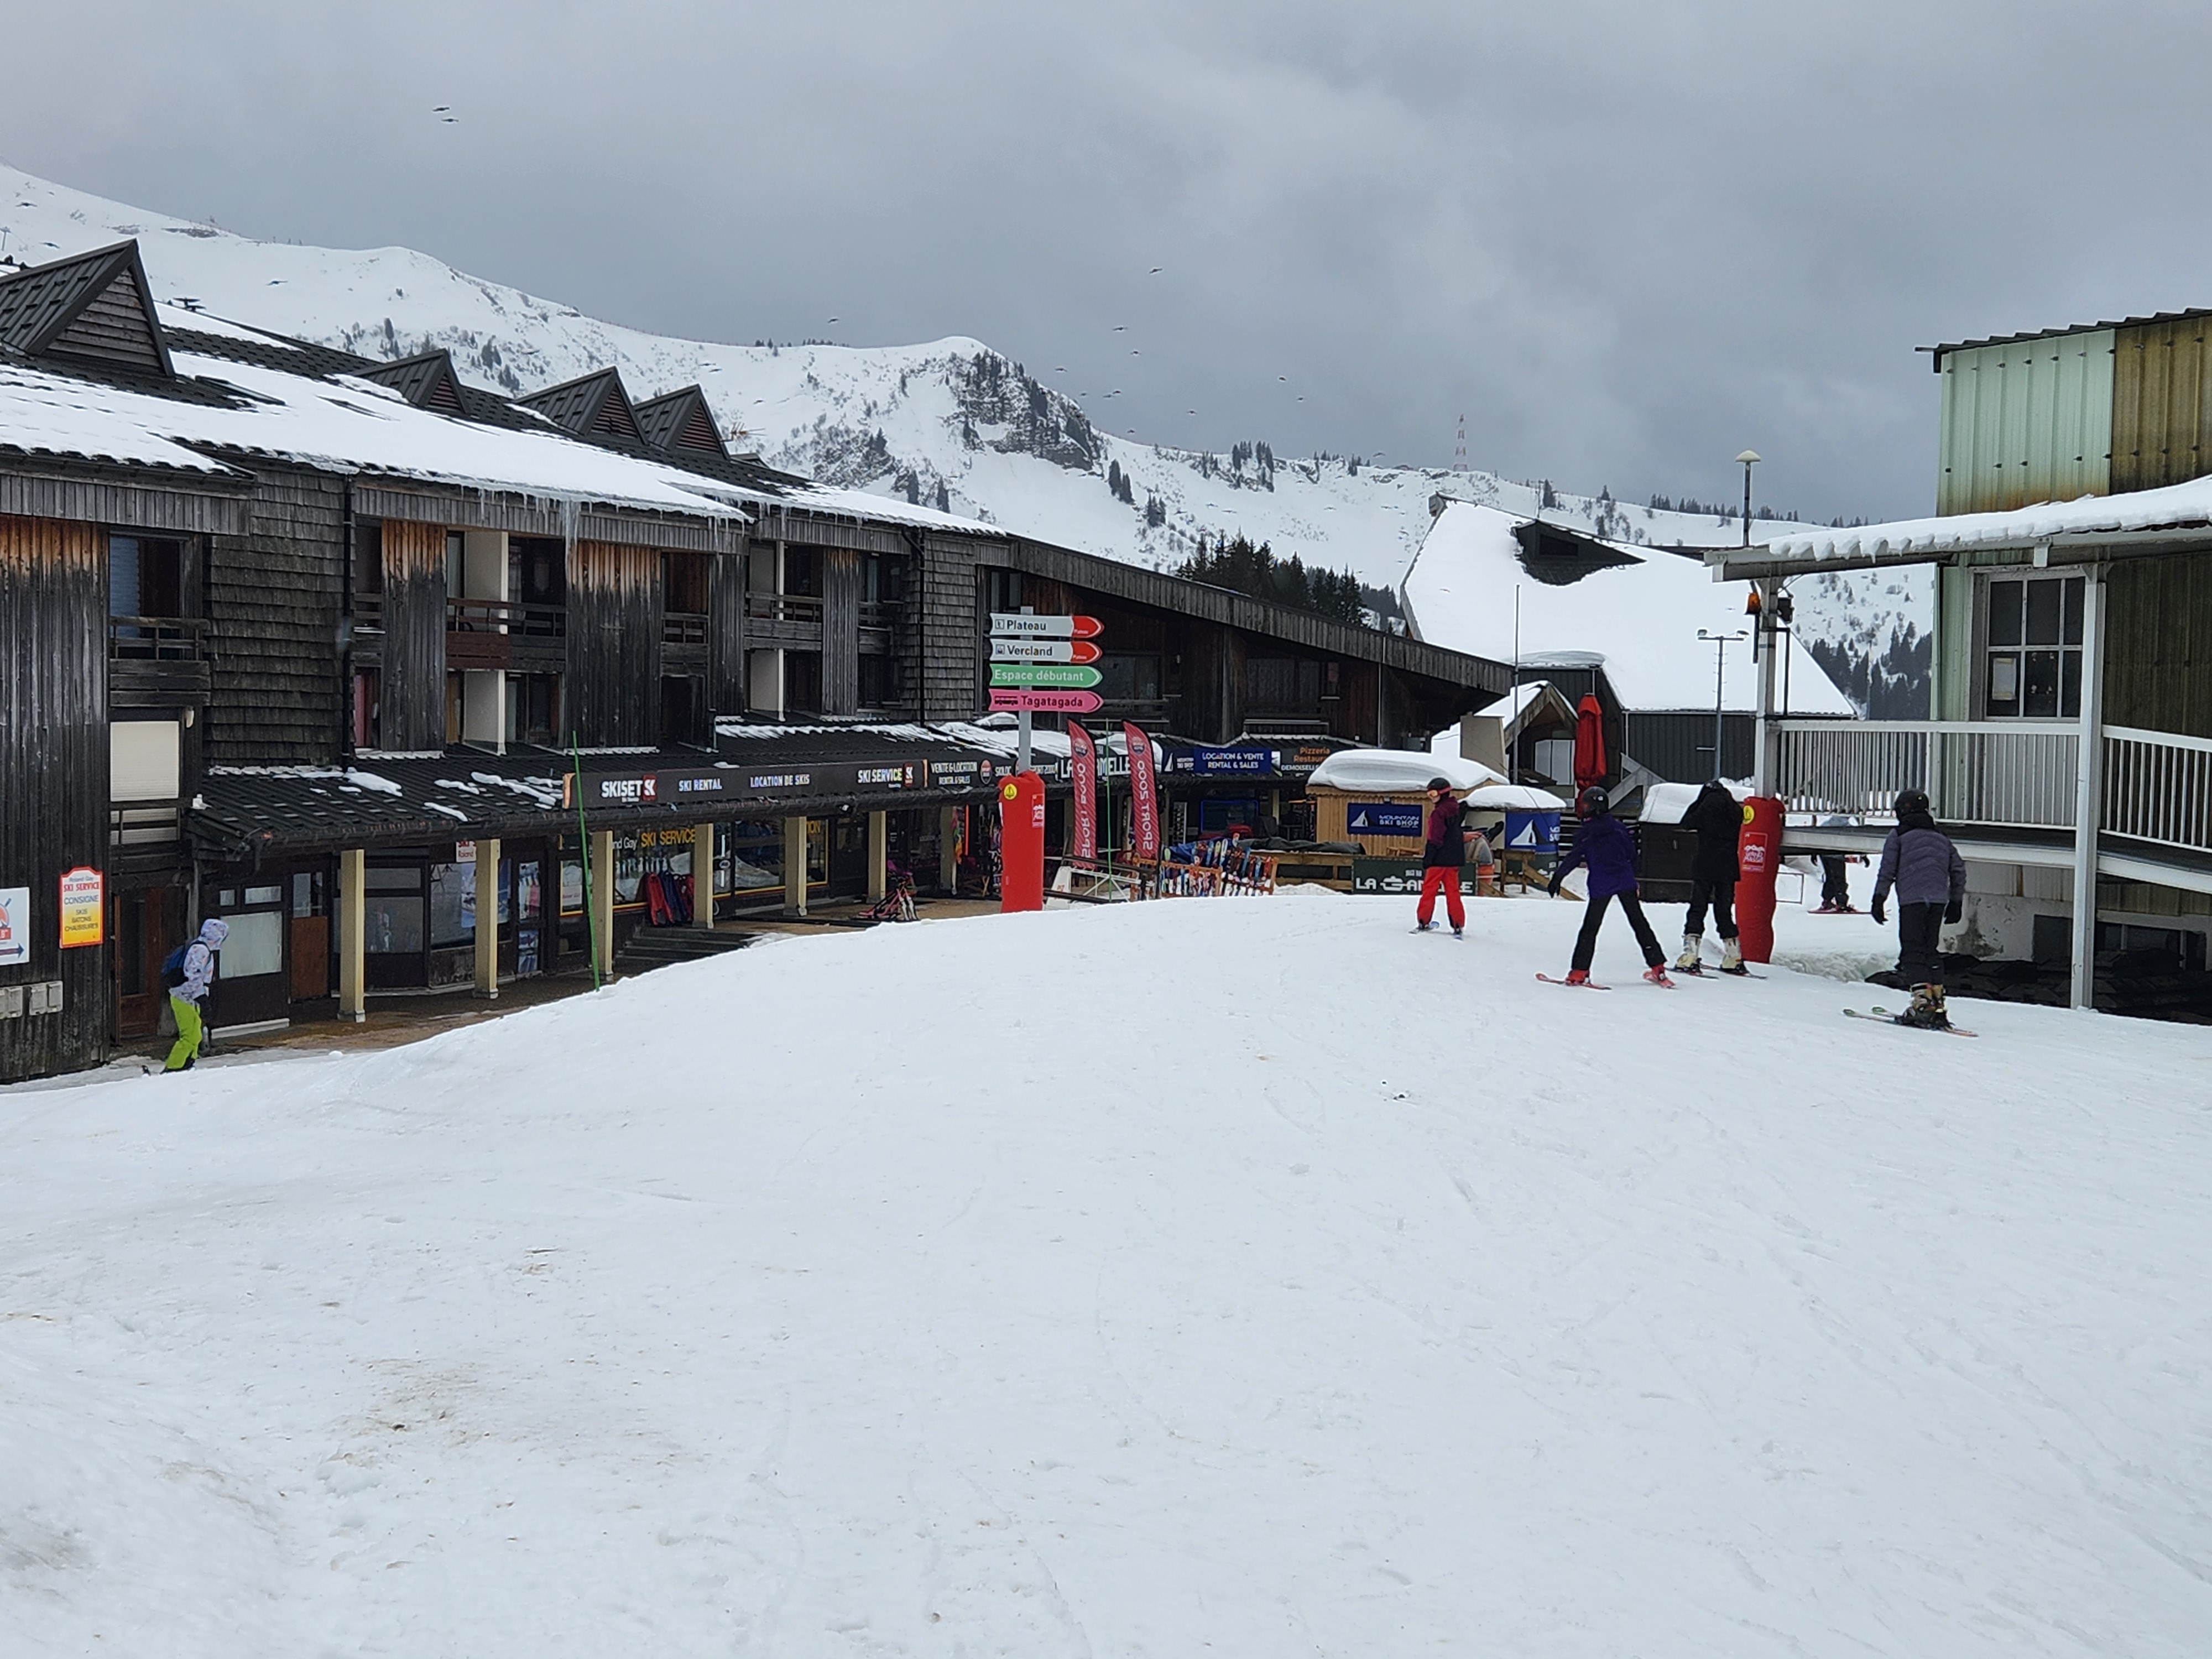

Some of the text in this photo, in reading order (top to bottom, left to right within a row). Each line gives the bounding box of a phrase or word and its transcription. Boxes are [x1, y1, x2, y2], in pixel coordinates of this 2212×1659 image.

[1006, 620, 1046, 630] Plateau
[1007, 645, 1052, 656] Vercland
[995, 669, 1084, 682] Espace débutant
[1021, 695, 1083, 708] Tagatagada
[750, 774, 810, 787] LOCATION DE SKIS
[858, 770, 871, 783] SKI
[872, 768, 902, 782] SERVICE
[601, 780, 643, 797] SKISET
[679, 778, 723, 792] SKI RENTAL
[624, 837, 637, 851] Gay
[641, 832, 656, 848] SKI
[660, 828, 696, 846] SERVICE
[76, 881, 100, 891] SERVICE
[1356, 878, 1376, 890] LA
[64, 895, 99, 905] CONSIGNE
